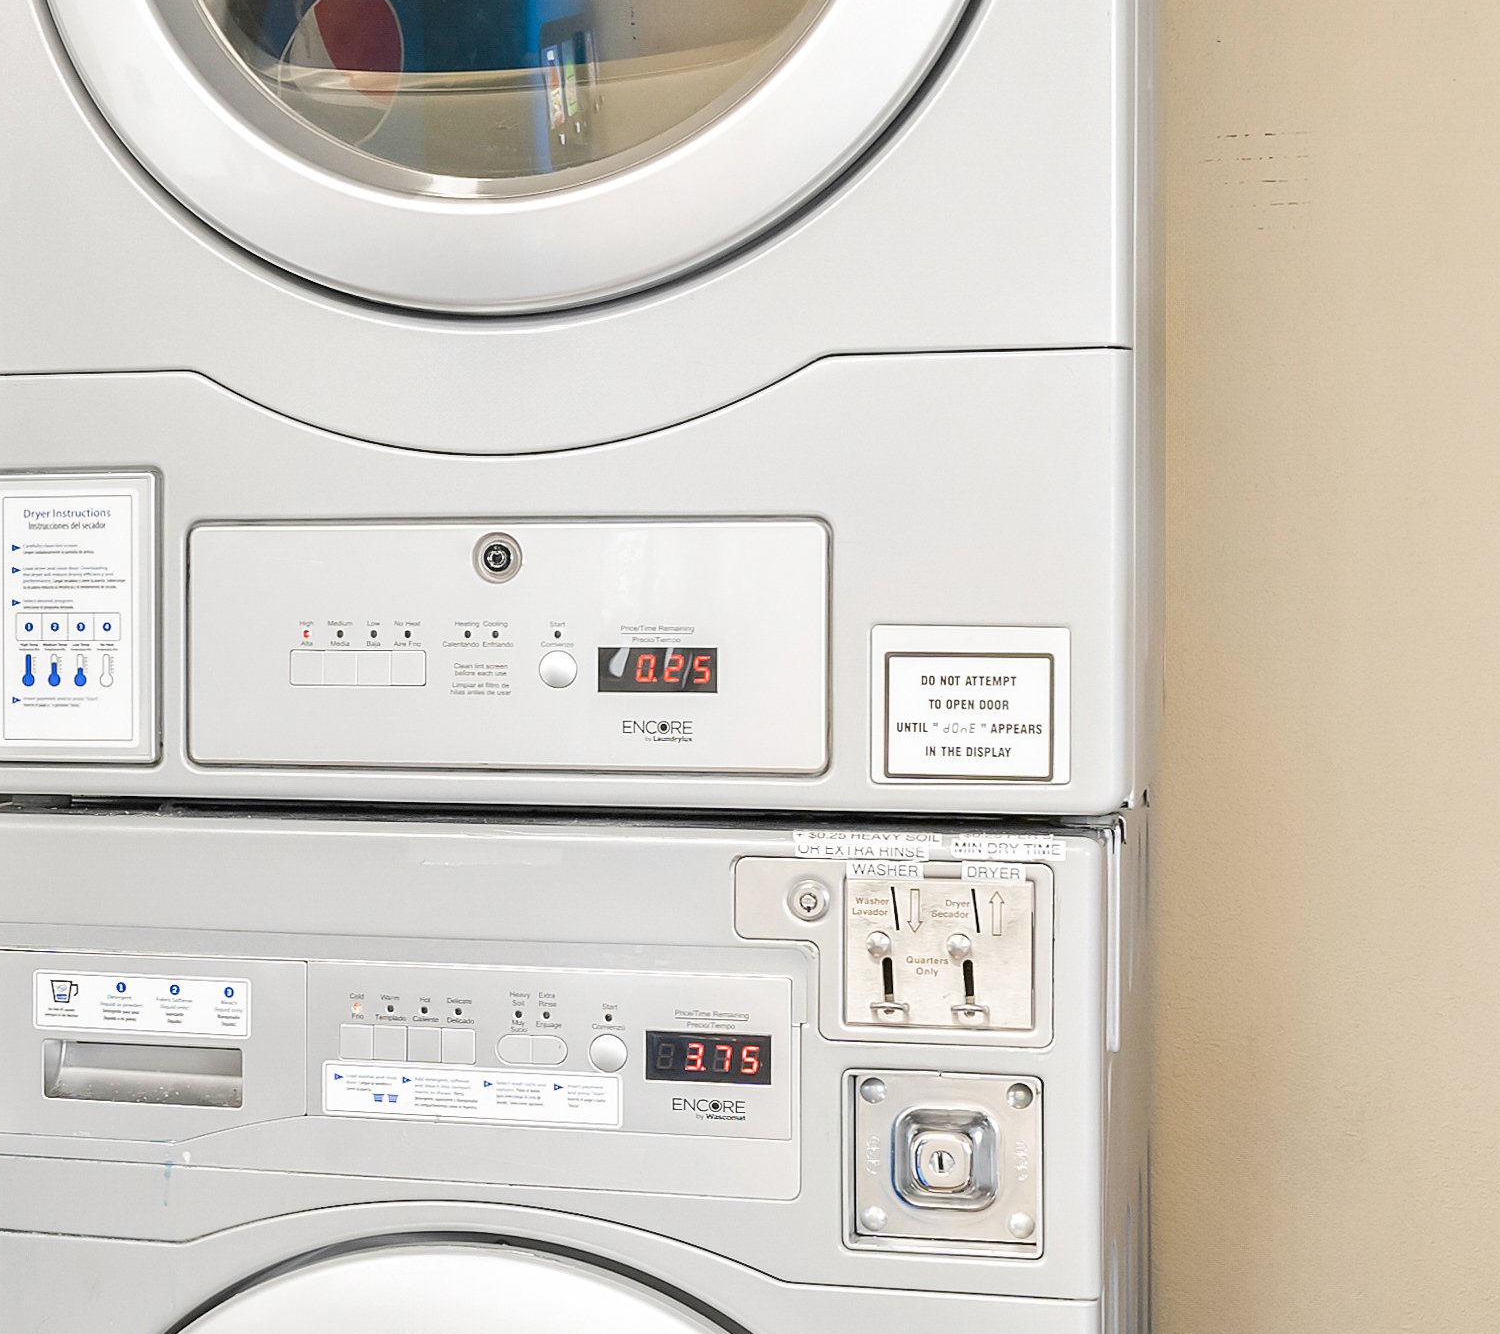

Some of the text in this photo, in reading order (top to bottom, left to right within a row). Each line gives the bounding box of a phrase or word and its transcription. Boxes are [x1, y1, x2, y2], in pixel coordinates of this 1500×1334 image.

[23, 508, 111, 519] Dryer Instructions
[28, 522, 106, 530] Instrucciones del secador
[482, 620, 508, 628] Cooling
[635, 654, 711, 684] 0.25
[921, 675, 1017, 687] DO NOT ATTEMPT
[928, 699, 1009, 711] TO OPEN DOOR
[622, 720, 693, 734] ENCORE
[896, 722, 929, 733] UNTIL
[990, 724, 1043, 735] APPEARS
[925, 746, 1012, 758] IN THE DISPLAY
[852, 863, 919, 878] WASHER
[967, 866, 1020, 880] DRYER
[855, 896, 889, 906] Washer
[945, 898, 970, 909] Dryer
[852, 907, 889, 917] Lavador
[931, 909, 969, 919] Secador
[905, 955, 949, 966] Quarters
[915, 967, 939, 977] Only
[509, 992, 531, 1000] Heavy
[685, 1042, 760, 1074] 3.75
[672, 1097, 746, 1113] ENCORE
